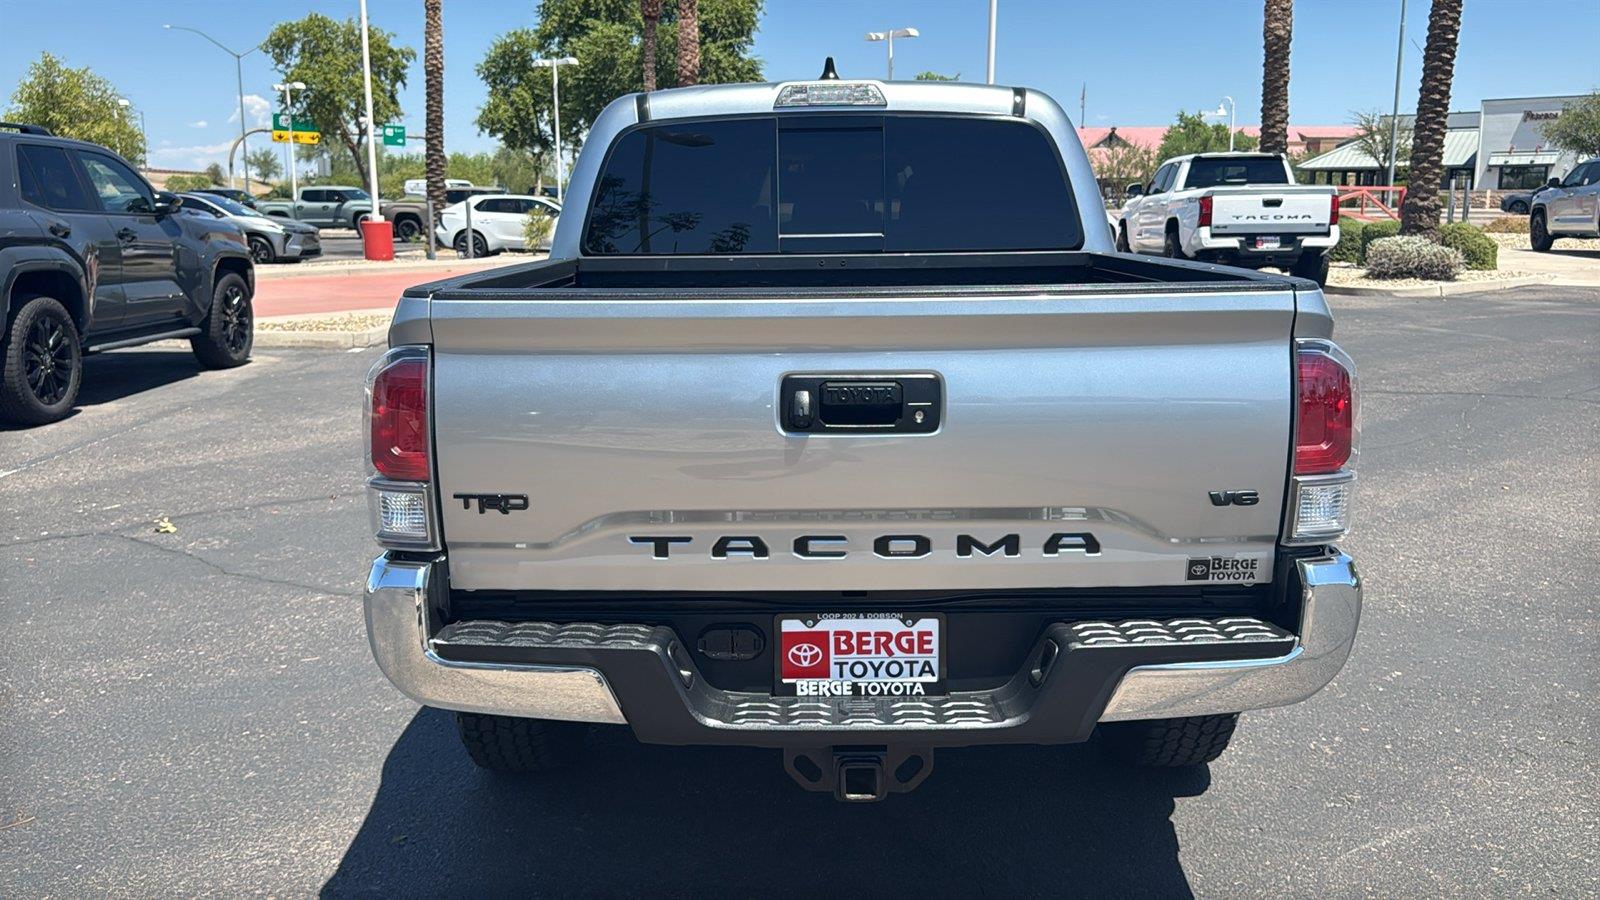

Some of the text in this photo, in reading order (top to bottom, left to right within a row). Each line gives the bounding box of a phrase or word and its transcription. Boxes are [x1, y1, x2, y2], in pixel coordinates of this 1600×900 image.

[827, 388, 892, 402] TOYOTA
[453, 494, 529, 514] TRD
[1208, 490, 1260, 506] V6
[627, 532, 1102, 560] TACOMA
[1211, 558, 1258, 571] BERGE
[1210, 572, 1256, 581] TOYOTA
[833, 630, 934, 657] BERGE
[834, 660, 936, 679] TOYOTA
[796, 680, 925, 697] BERGE TOYOTA
